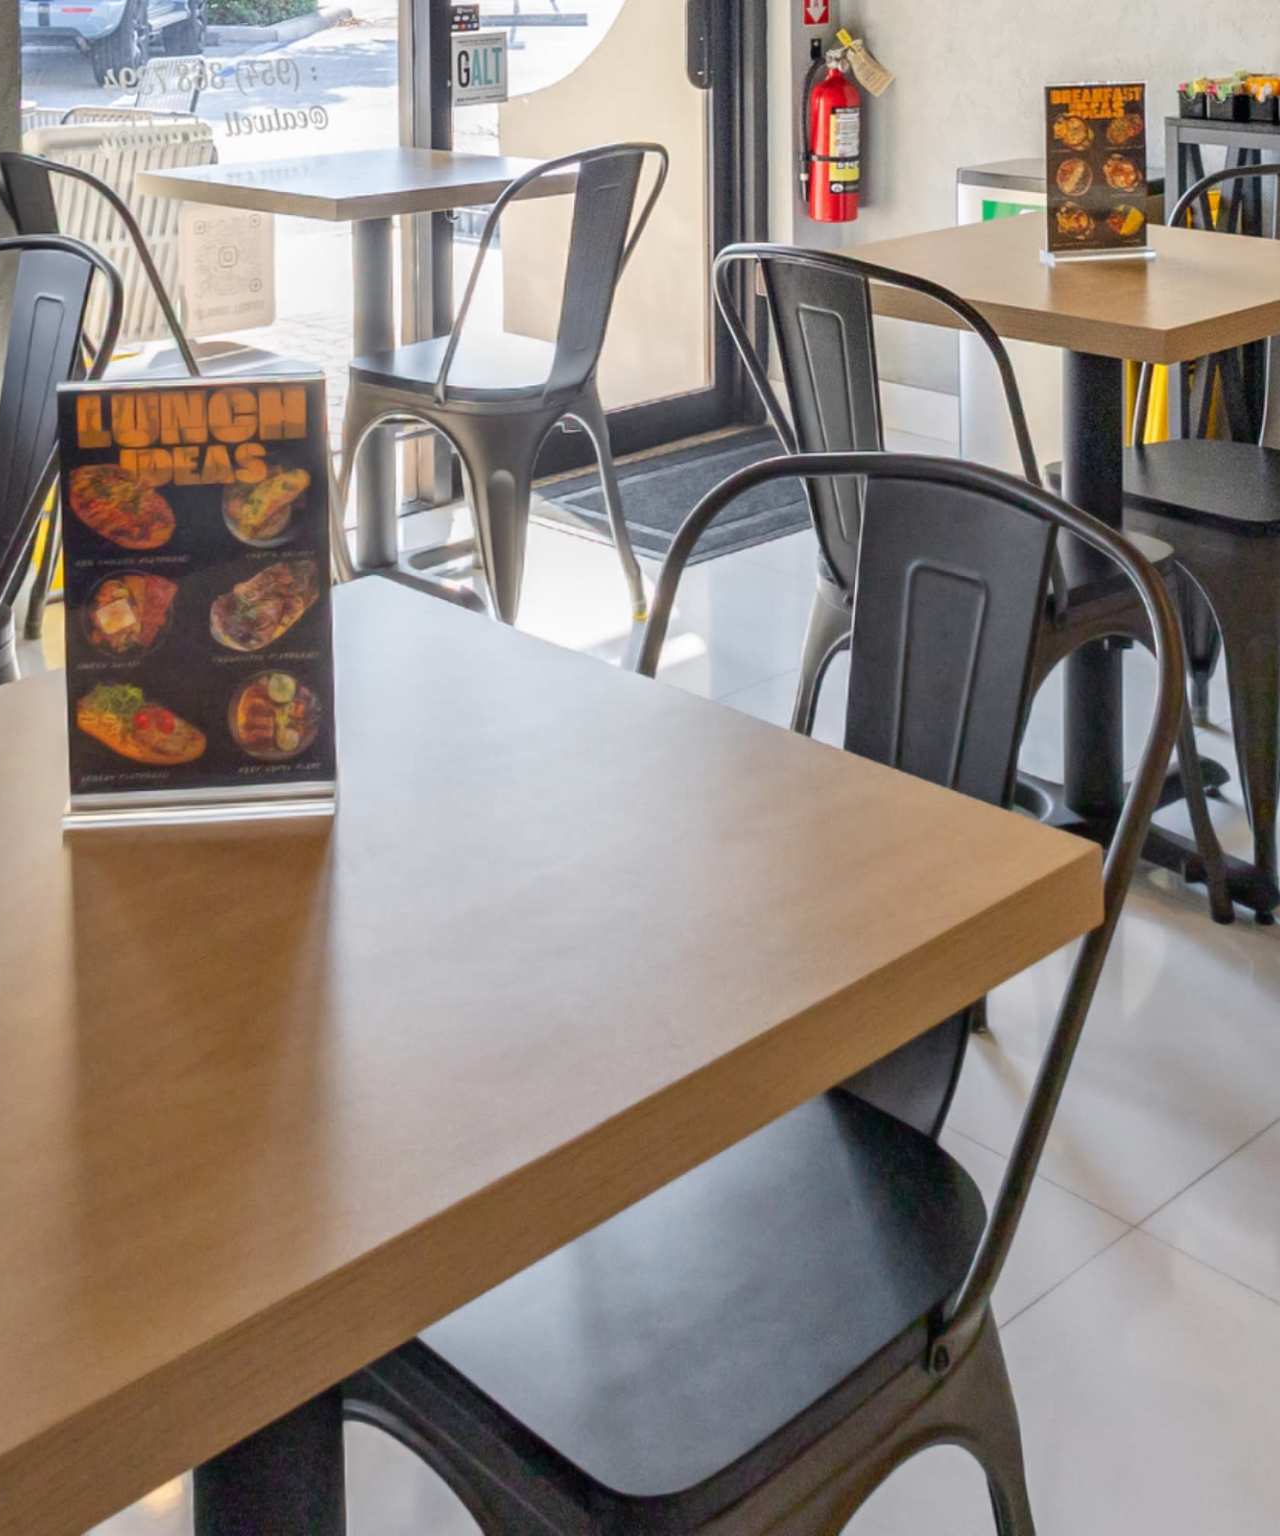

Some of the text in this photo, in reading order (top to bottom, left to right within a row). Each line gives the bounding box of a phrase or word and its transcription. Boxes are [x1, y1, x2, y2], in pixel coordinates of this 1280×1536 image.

[457, 47, 503, 89] GALT
[75, 384, 308, 450] LUNCH
[118, 442, 269, 488] IDEAS
